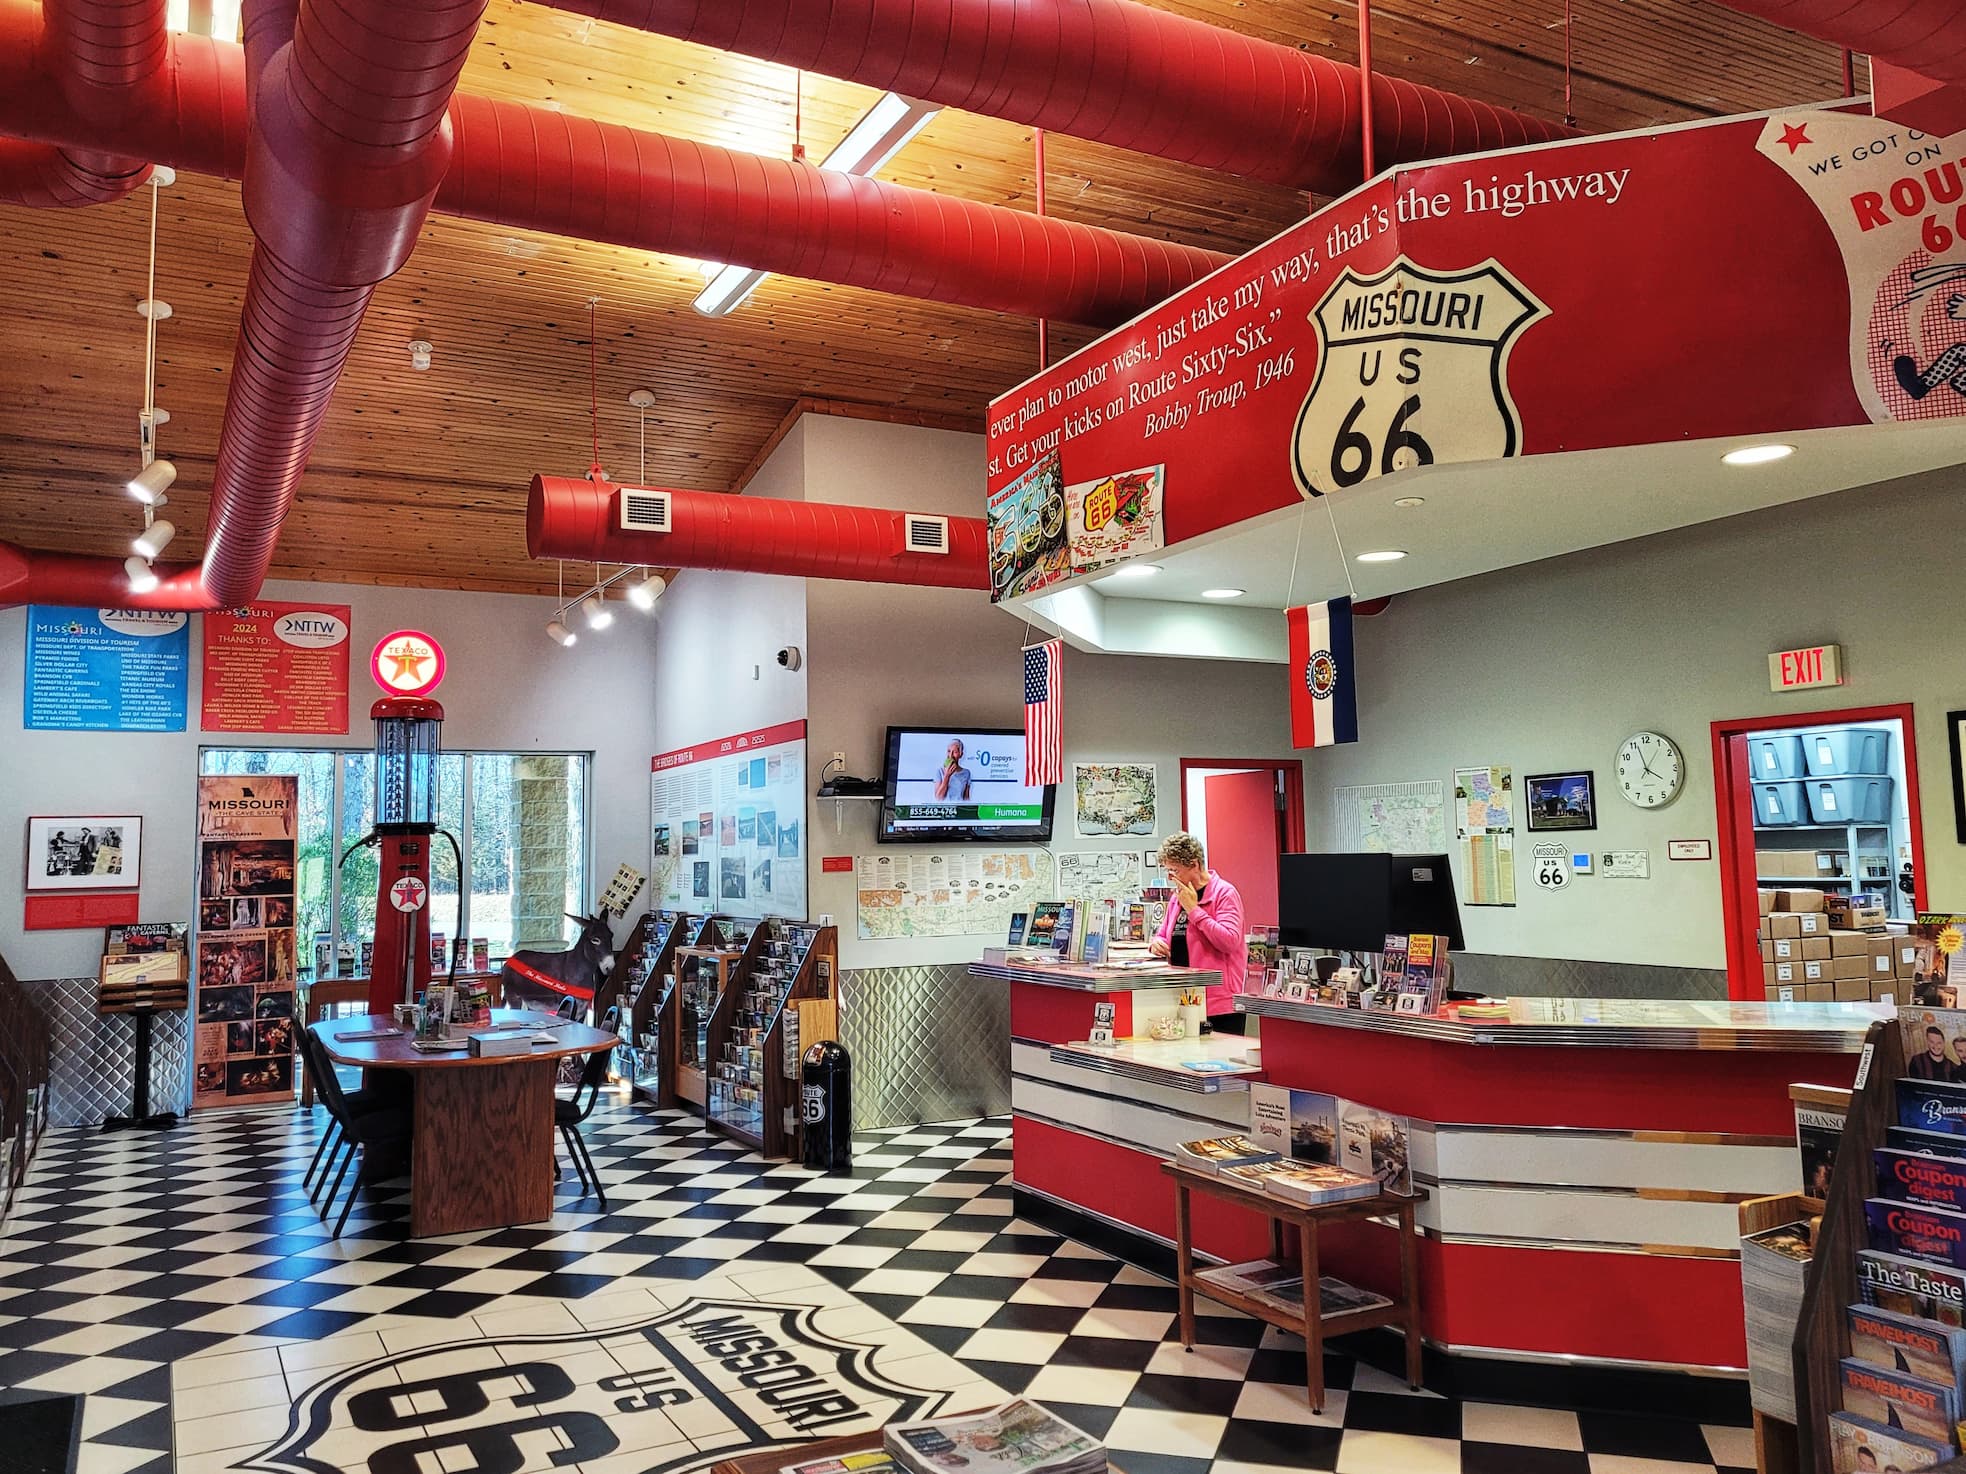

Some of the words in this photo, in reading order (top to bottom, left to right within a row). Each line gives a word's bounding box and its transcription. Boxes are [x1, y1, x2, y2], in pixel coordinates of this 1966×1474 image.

[1808, 154, 1843, 177] WE
[1852, 133, 1899, 162] GOT
[1906, 143, 1942, 166] ON
[990, 411, 1015, 440] ever
[1018, 398, 1045, 432] plan
[1048, 388, 1062, 409] to
[1066, 360, 1109, 400] motor
[1114, 337, 1152, 374] west,
[1154, 316, 1188, 361] just
[1190, 295, 1229, 333] take
[1233, 275, 1265, 311] my
[1270, 247, 1320, 288] way,
[1325, 204, 1390, 260] that's
[1395, 187, 1451, 224] the
[1462, 168, 1631, 218] highway
[1341, 289, 1484, 332] MISSOURI
[1144, 400, 1192, 439] Bobby
[1196, 380, 1247, 417] Troup,
[1254, 346, 1296, 391] 1946
[987, 458, 1003, 478] st.
[1006, 442, 1028, 469] Get
[1030, 426, 1062, 464] your
[1064, 412, 1102, 442] kicks
[1105, 396, 1124, 421] on
[1128, 370, 1177, 409] Route
[1330, 393, 1434, 488] 66
[1089, 485, 1112, 509] ROUTE
[1091, 499, 1111, 527] 66
[36, 623, 102, 636] MISSOURI
[232, 623, 258, 633] 2024
[294, 620, 336, 633] NTTW
[218, 635, 254, 644] THANKS
[257, 637, 272, 645] TO:
[388, 647, 429, 656] TEXACO
[1780, 648, 1824, 686] EXIT
[1630, 742, 1637, 750] 11
[1641, 735, 1651, 745] 12
[1656, 739, 1661, 747] 1
[991, 755, 1012, 763] copays
[1622, 753, 1631, 761] 10
[1667, 749, 1673, 757] 2
[1619, 768, 1625, 776] 9
[1673, 764, 1678, 772] 3
[1625, 782, 1630, 790] 8
[1669, 779, 1675, 787] 4
[1635, 792, 1641, 801] 7
[1648, 796, 1654, 804] 6
[1661, 791, 1667, 799] 5
[208, 799, 289, 810] MISSOURI
[994, 807, 1027, 817] Humana
[1536, 847, 1564, 856] MISSOURI
[1540, 868, 1563, 885] 66
[1920, 915, 1947, 924] OZARK
[127, 924, 169, 932] FANTASTIC
[1894, 1159, 1966, 1188] Coupon
[1909, 1181, 1955, 1201] digest
[1887, 1211, 1961, 1242] Coupon
[1901, 1234, 1948, 1255] digest
[1862, 1260, 1902, 1286] The
[1905, 1270, 1963, 1300] Taste
[681, 1313, 873, 1431] MISSOURI
[596, 1366, 694, 1415] US
[347, 1361, 621, 1474] 66
